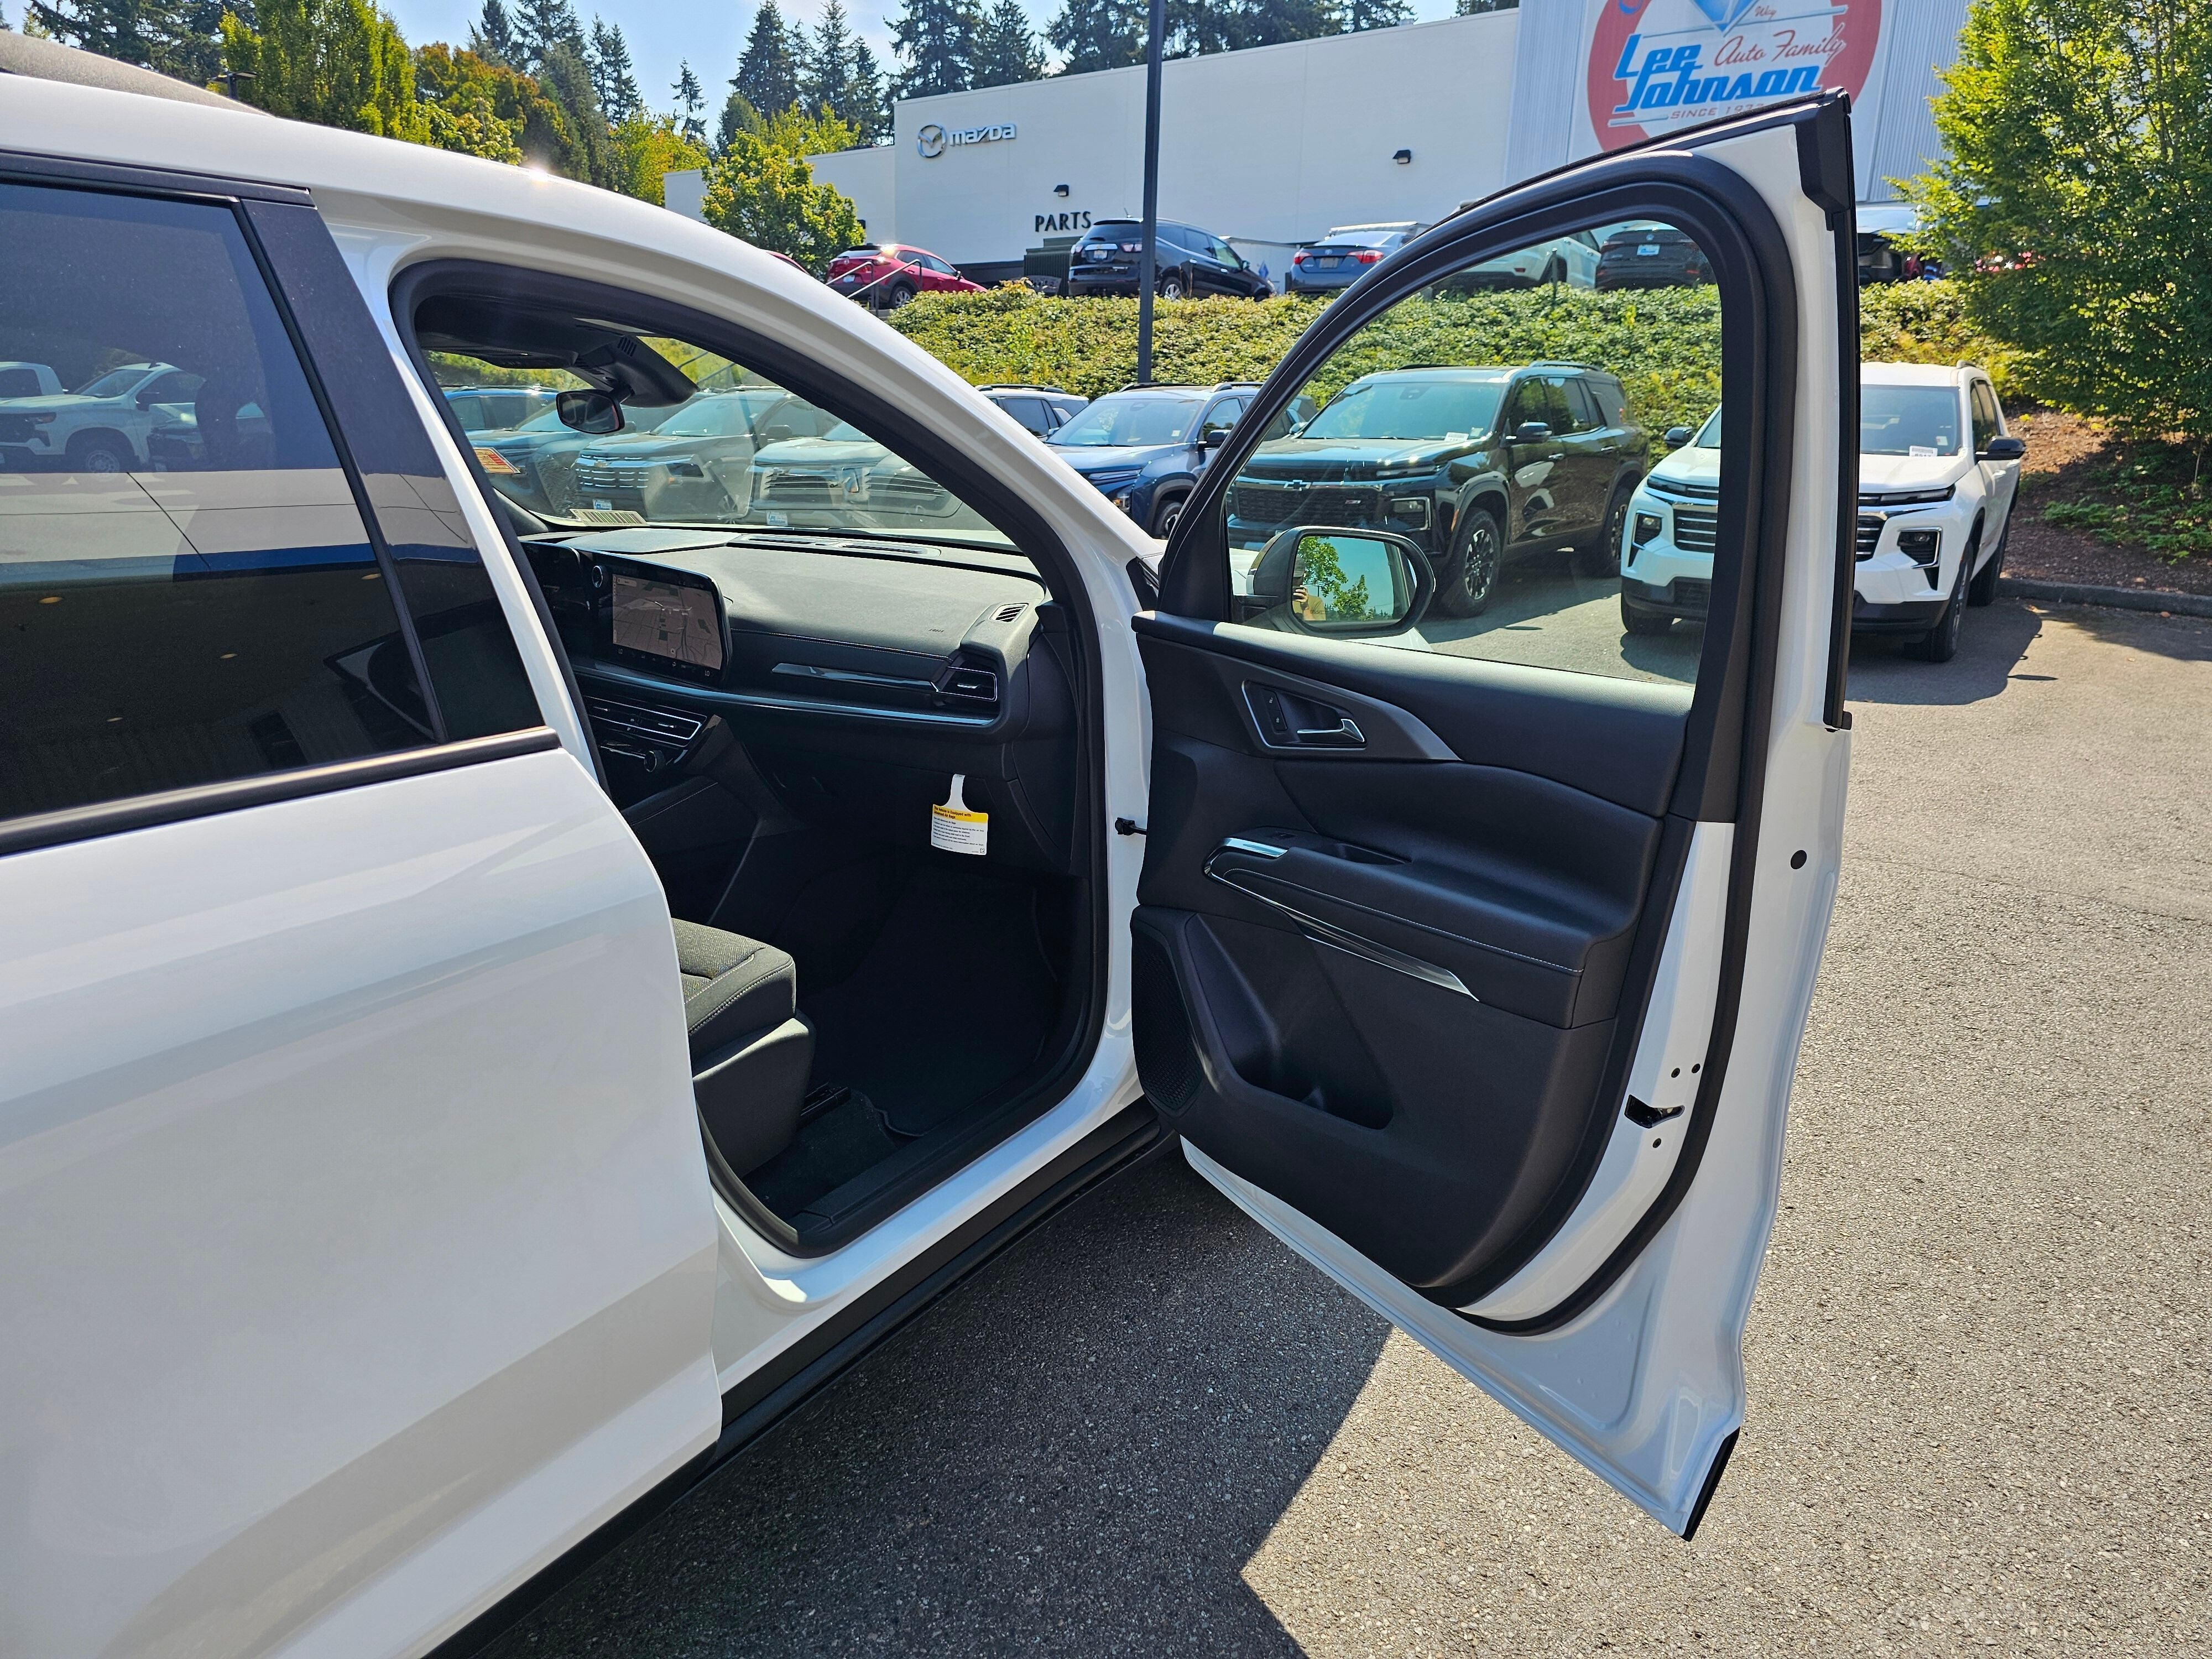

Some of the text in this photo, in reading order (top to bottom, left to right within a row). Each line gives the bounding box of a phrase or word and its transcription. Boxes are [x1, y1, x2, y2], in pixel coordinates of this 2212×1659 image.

[1614, 34, 1702, 79] Lee
[1714, 23, 1846, 66] Auto Family
[1614, 61, 1822, 112] Johnson
[1671, 108, 1717, 119] SINCE
[1035, 211, 1092, 232] PARTS
